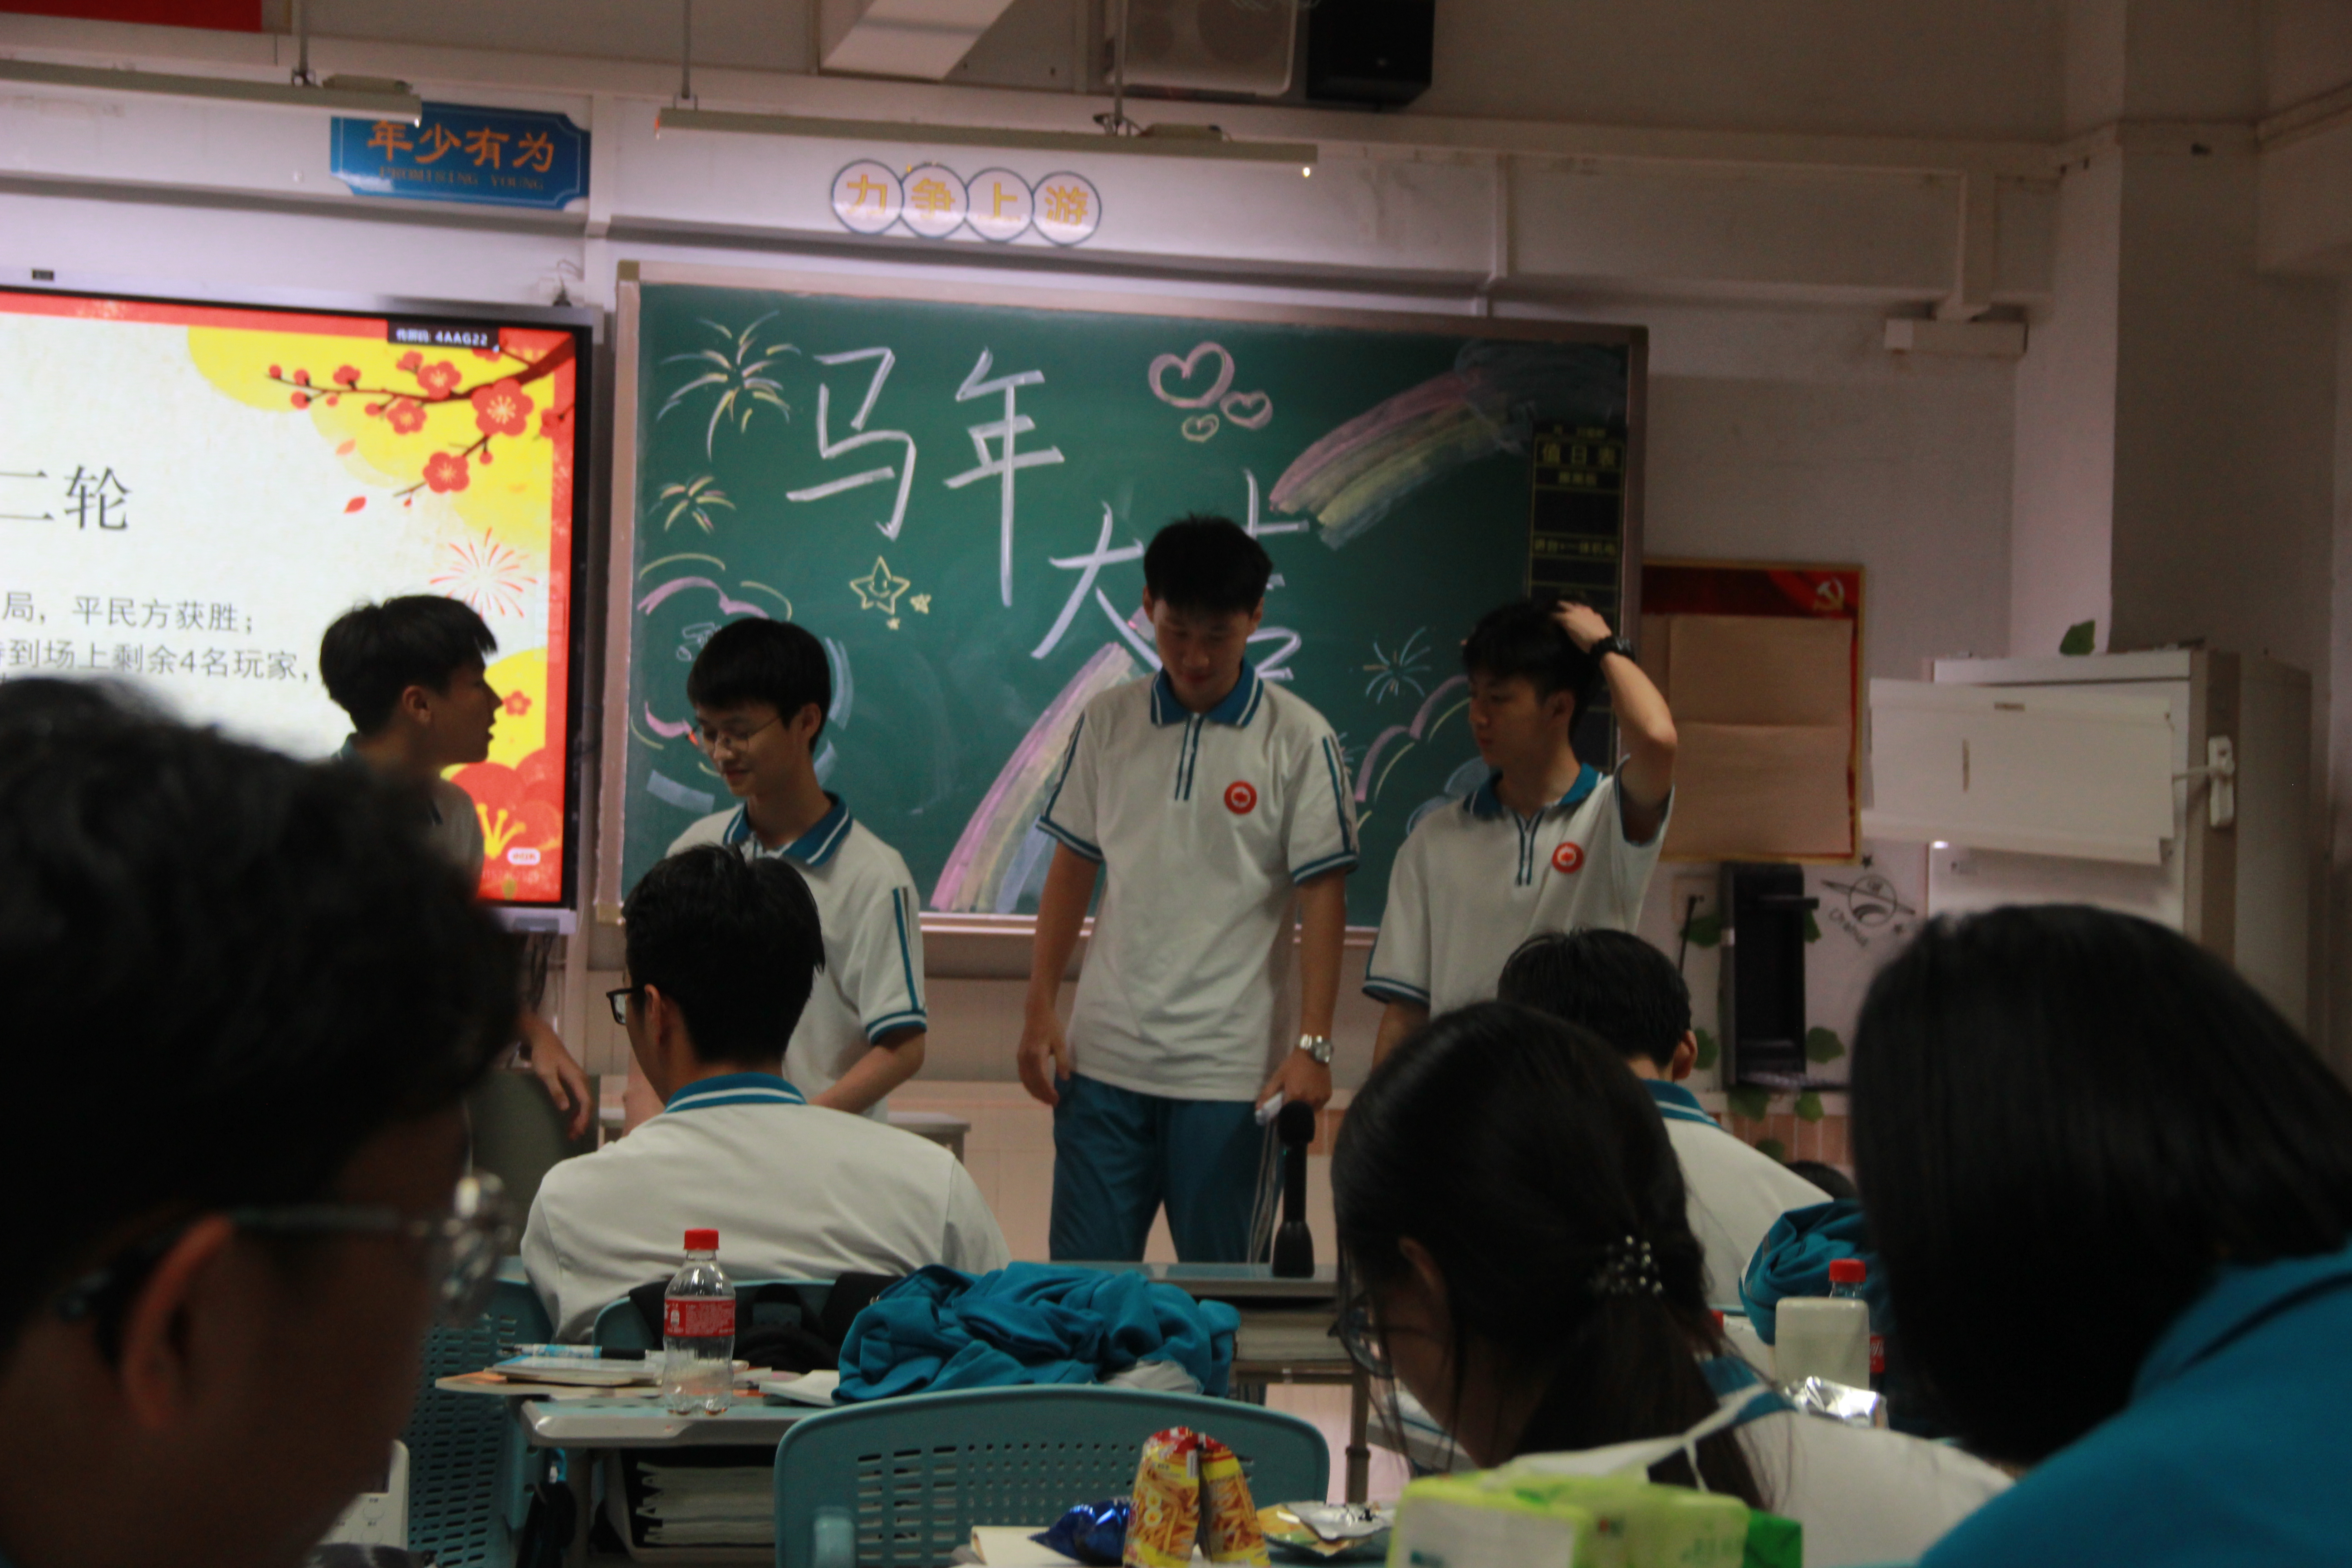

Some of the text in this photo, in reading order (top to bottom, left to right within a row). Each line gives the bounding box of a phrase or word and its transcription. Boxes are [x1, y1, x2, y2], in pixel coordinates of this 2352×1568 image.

[368, 120, 554, 173] 年少有为
[847, 174, 1089, 225] 力争上游
[435, 329, 488, 347] 4AAG22
[0, 464, 133, 531] 二轮
[786, 345, 1065, 608] 马年
[0, 638, 309, 683] 到场上剩余4名玩家，
